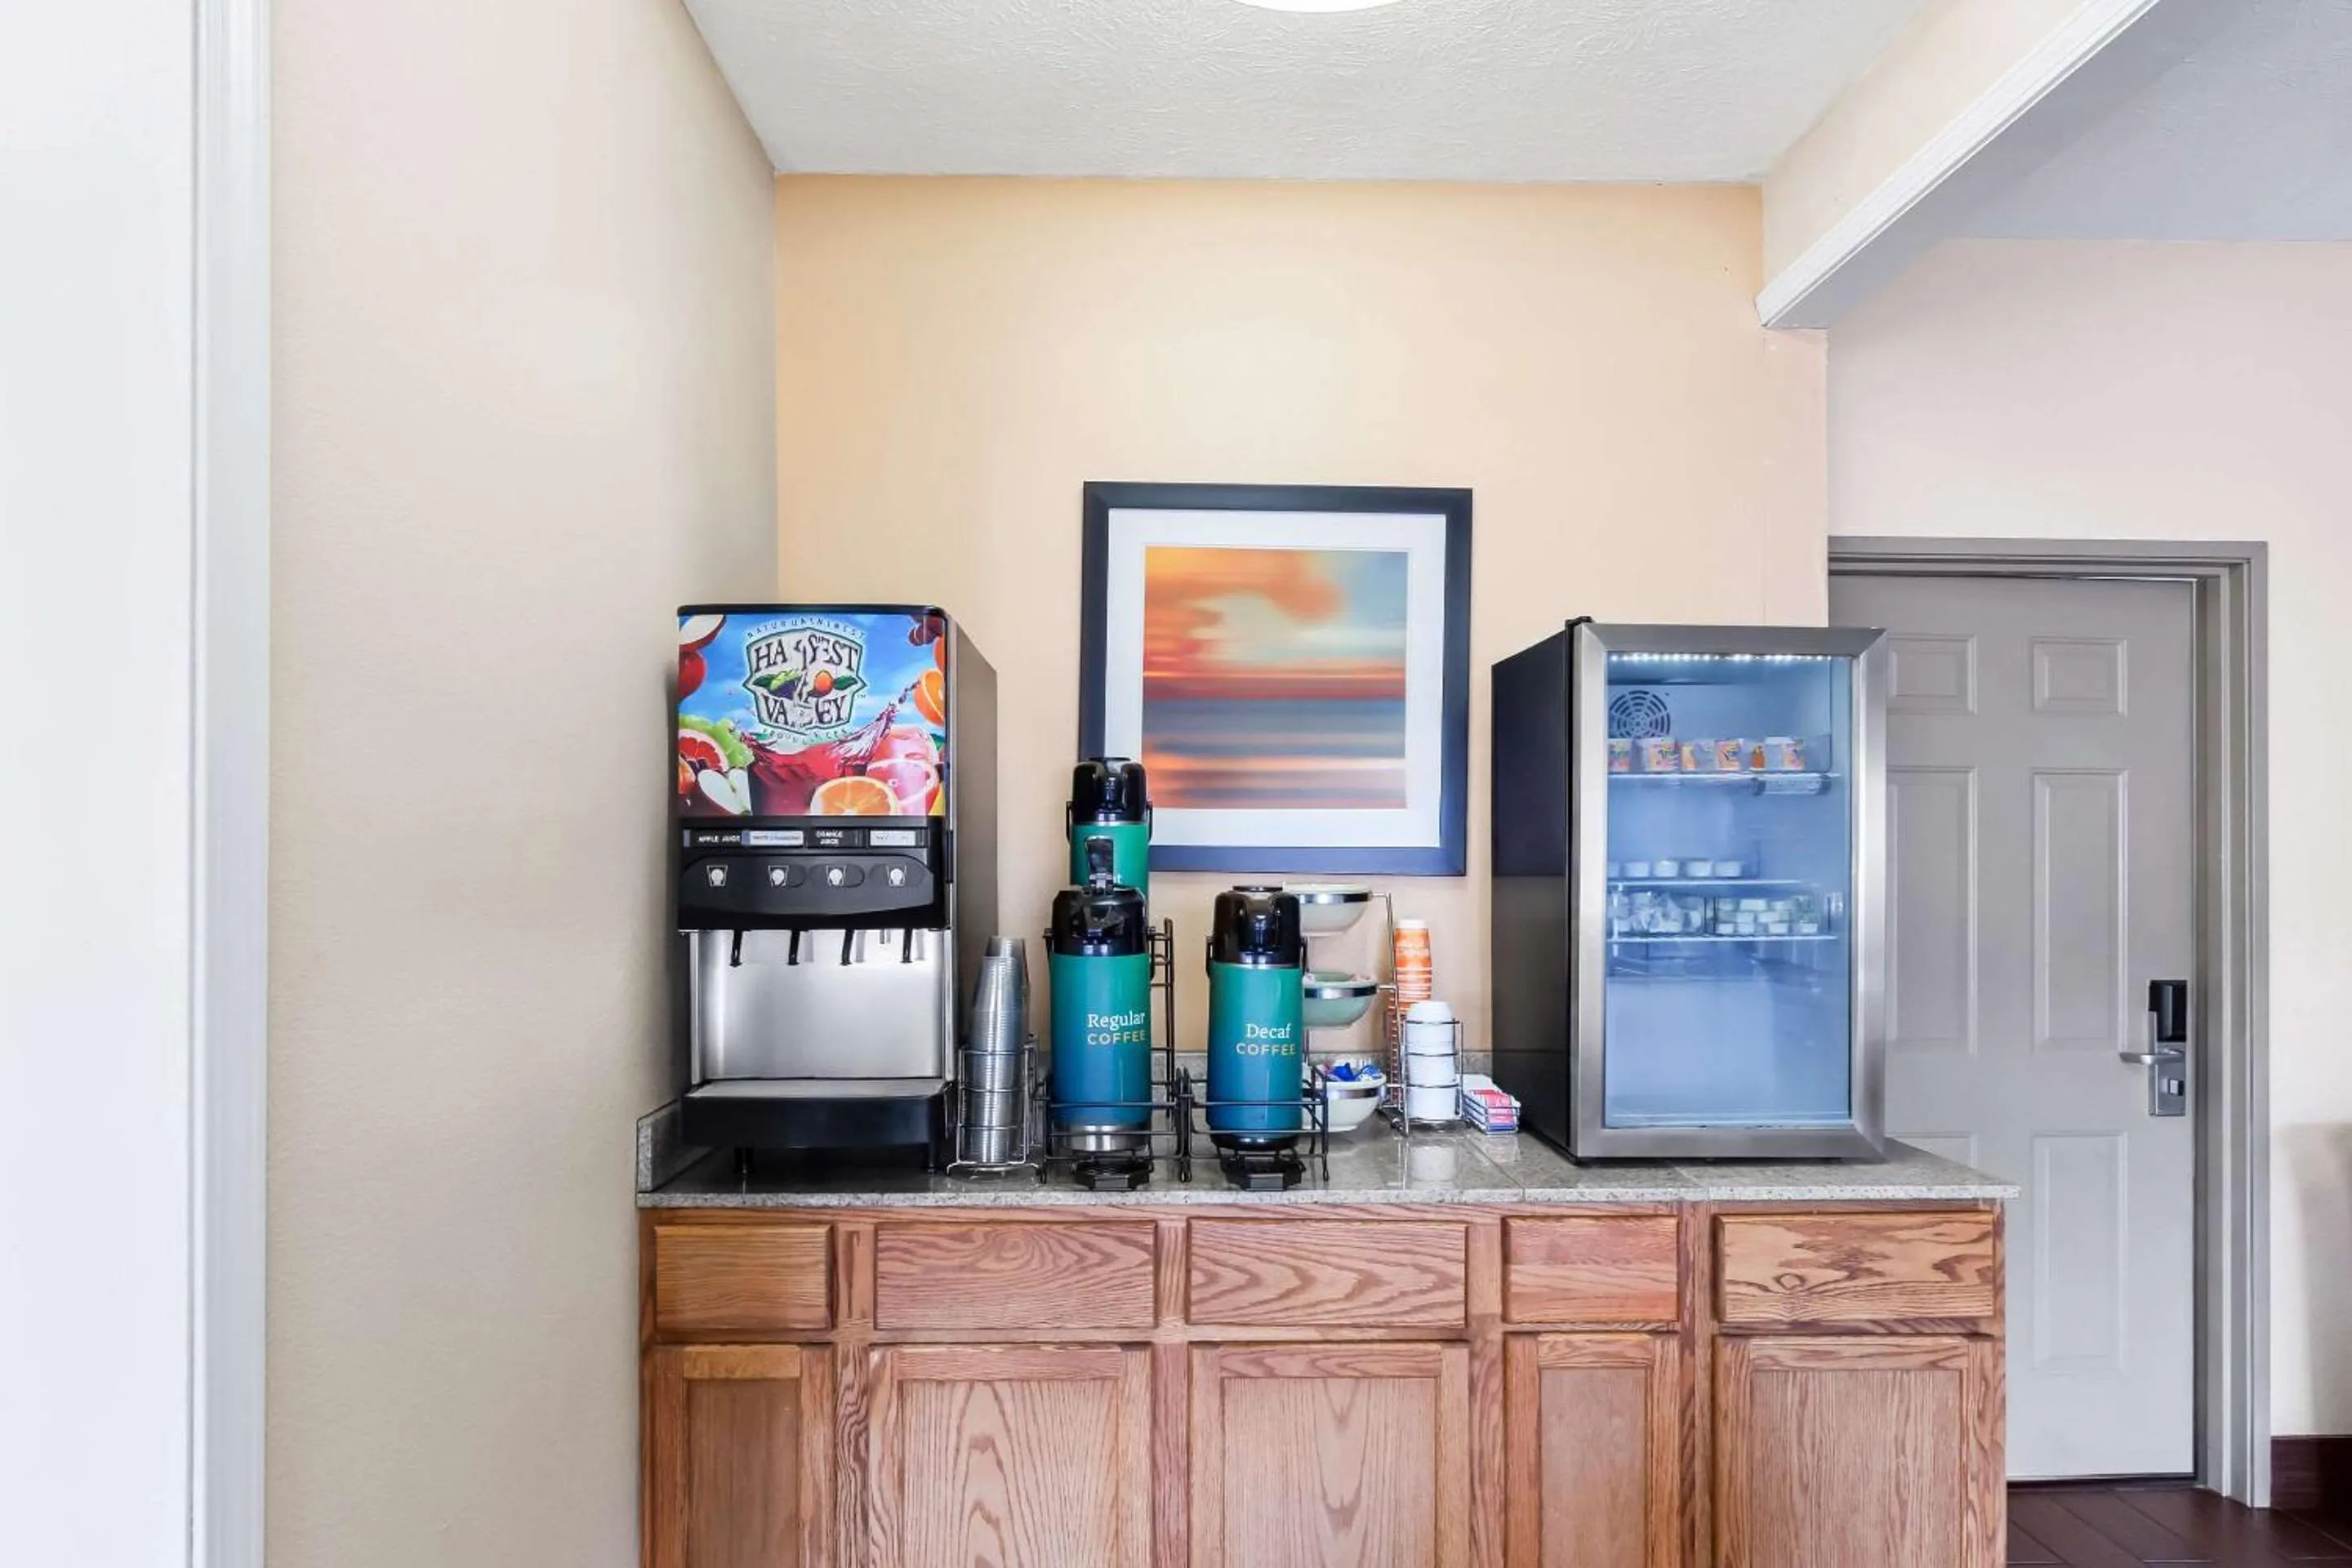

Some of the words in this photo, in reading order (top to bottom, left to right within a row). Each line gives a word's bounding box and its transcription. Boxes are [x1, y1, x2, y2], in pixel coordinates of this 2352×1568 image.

[1087, 1009, 1145, 1031] Regular
[1087, 1029, 1147, 1045] COFFEE
[1245, 1022, 1292, 1039] Decaf
[1236, 1042, 1296, 1056] COFFEE
